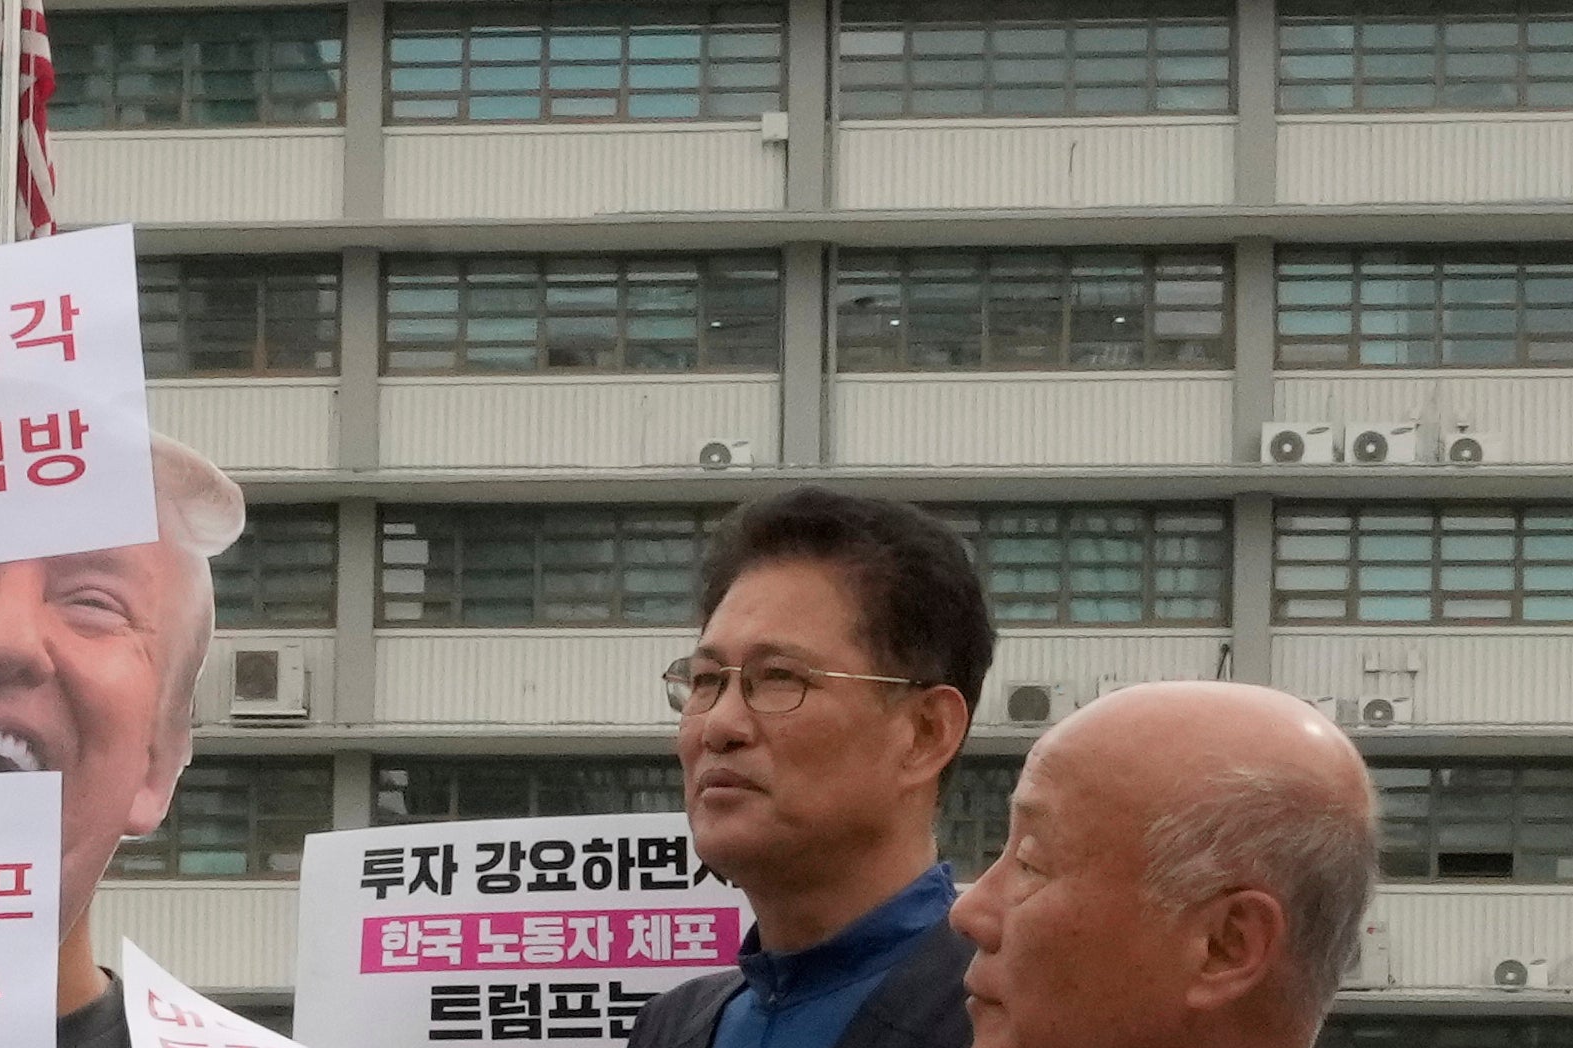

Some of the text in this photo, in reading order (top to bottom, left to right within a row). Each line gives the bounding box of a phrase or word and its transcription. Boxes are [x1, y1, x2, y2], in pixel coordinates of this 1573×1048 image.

[360, 835, 740, 900] 투자 강요하면
[379, 913, 719, 967] 한국 노동자 체포
[429, 980, 663, 1041] 트럼프는
